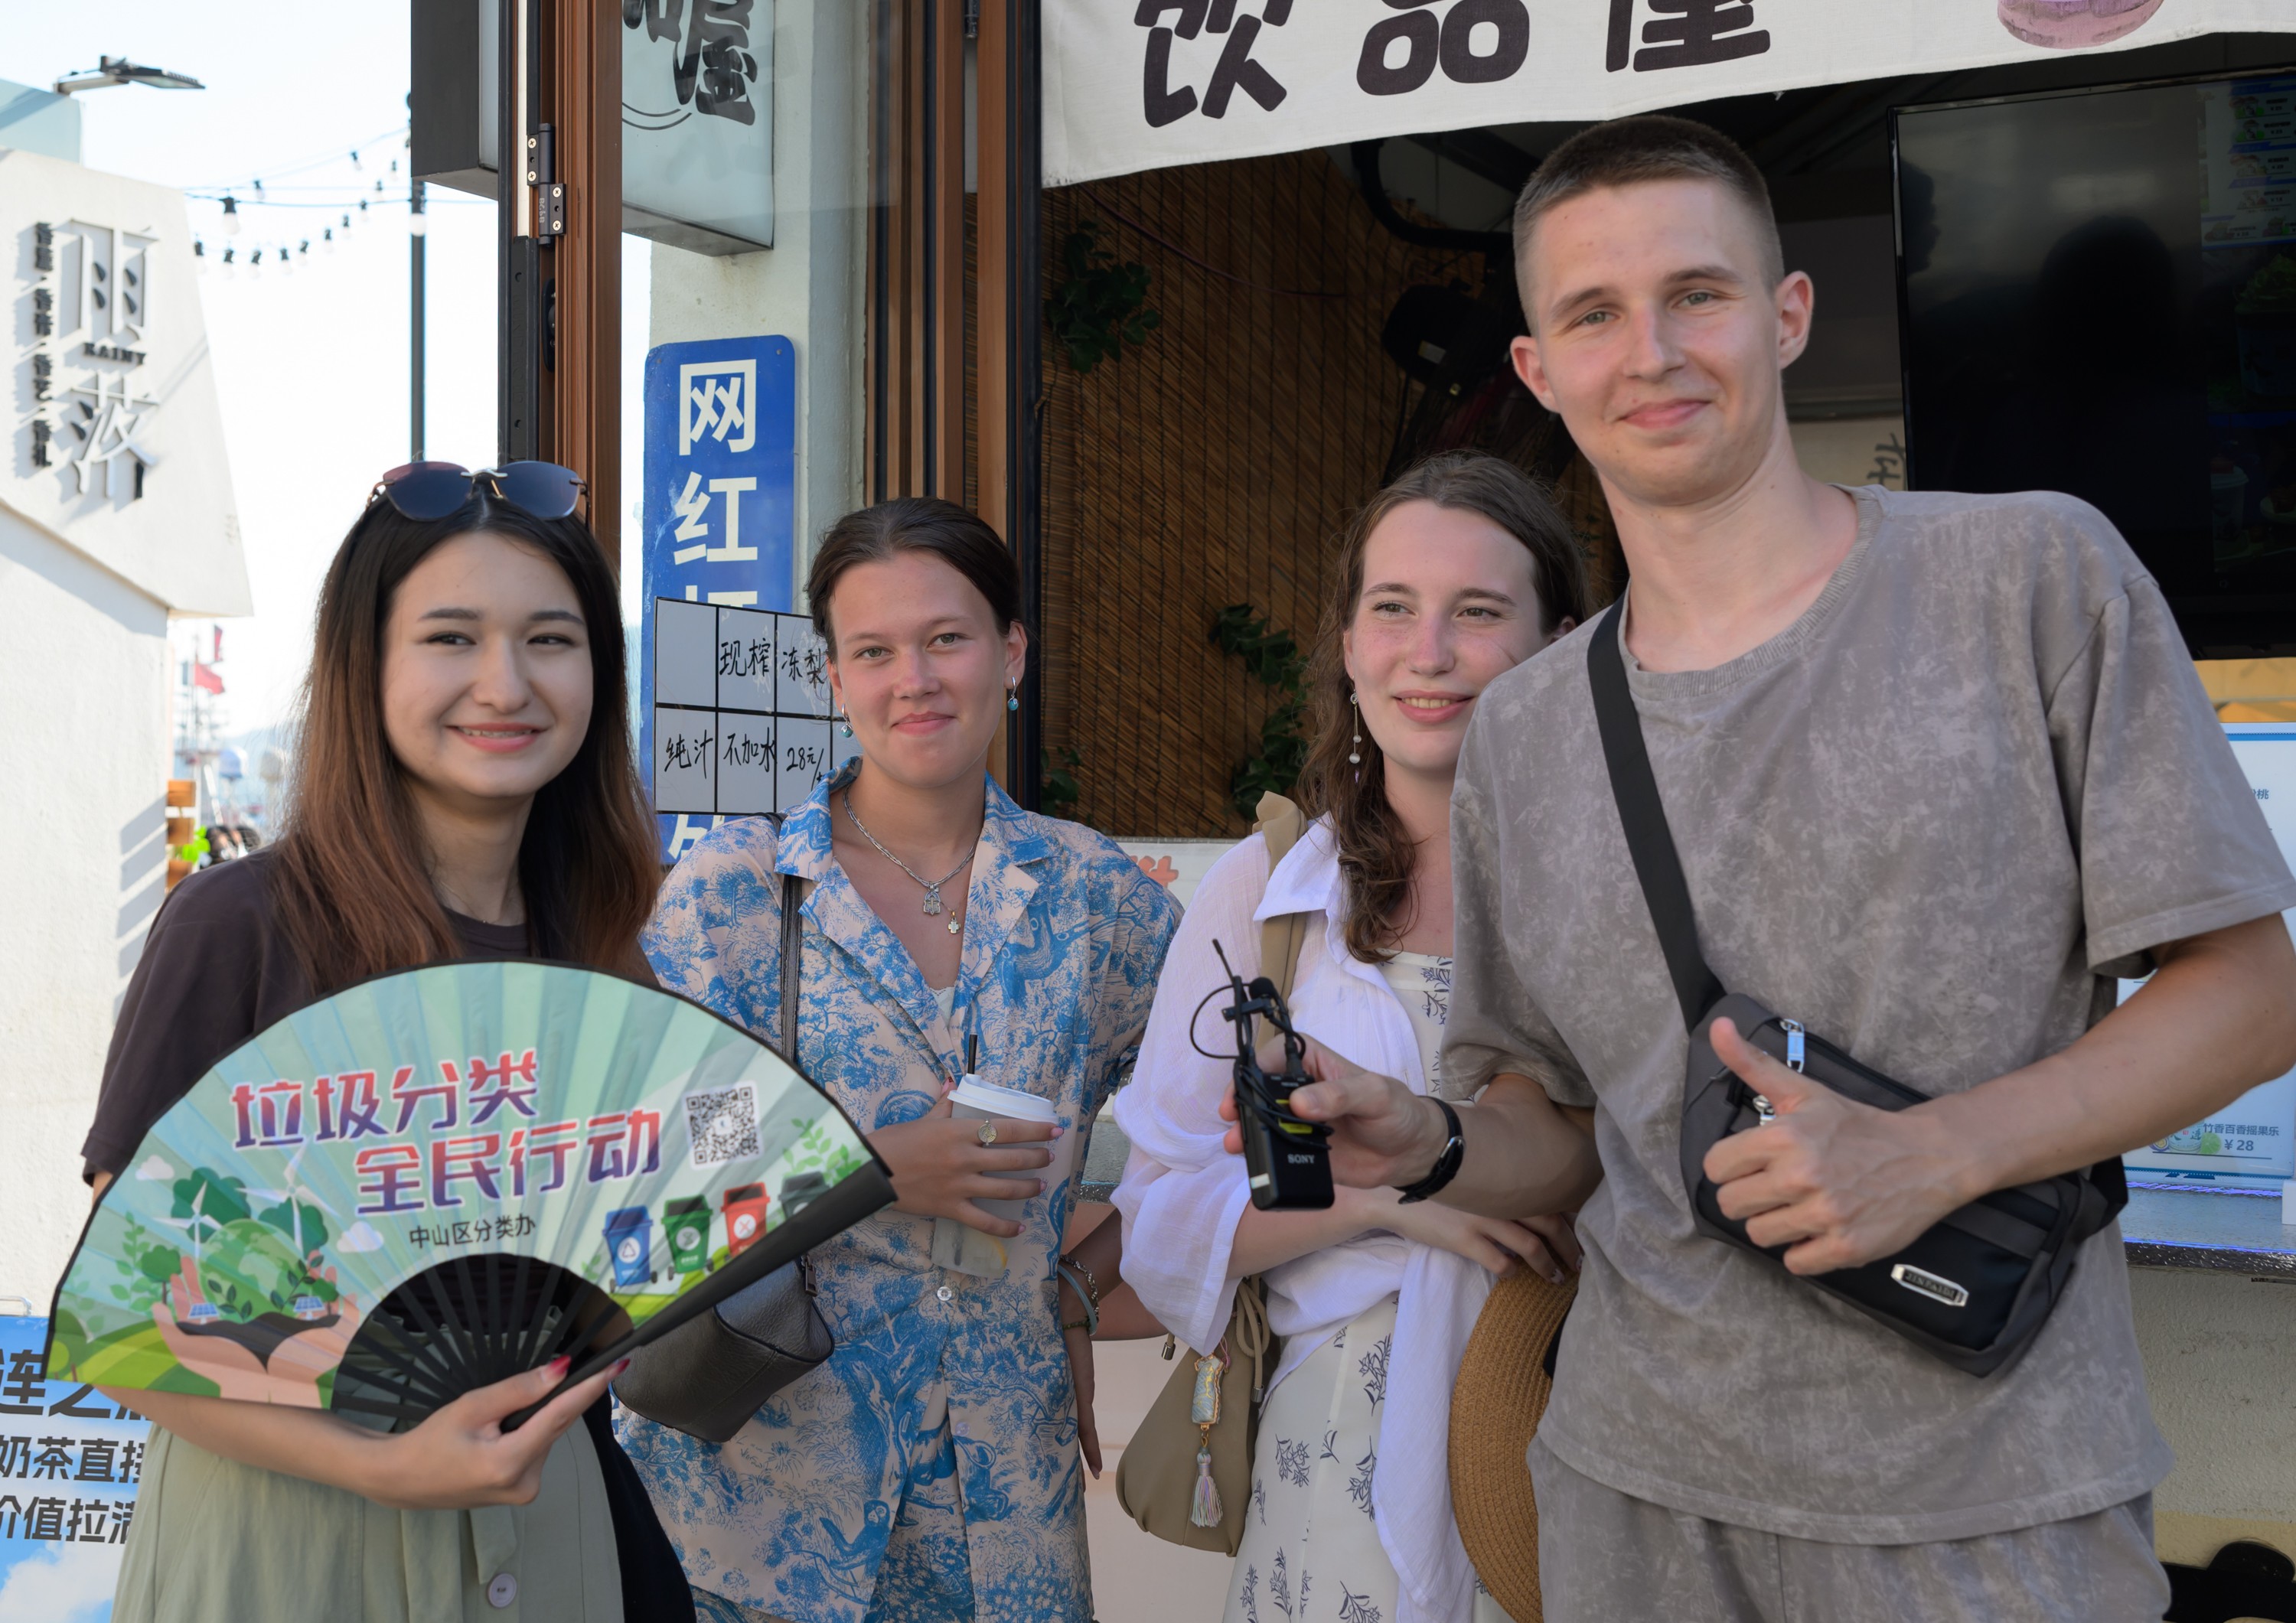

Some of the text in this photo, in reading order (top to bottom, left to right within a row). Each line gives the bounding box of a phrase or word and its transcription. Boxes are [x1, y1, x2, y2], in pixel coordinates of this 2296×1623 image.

[83, 341, 147, 367] RAINY
[719, 638, 771, 677] 现榨
[664, 729, 713, 779] 纯汁
[723, 727, 778, 773] 不加水
[232, 1049, 537, 1149] 垃圾分类
[2203, 1123, 2279, 1137] 竹香百香摇果乐
[354, 1109, 661, 1215] 全民行动
[1287, 1153, 1316, 1164] SONY
[409, 1214, 536, 1250] 中山区分类办
[0, 1348, 154, 1421] 连之
